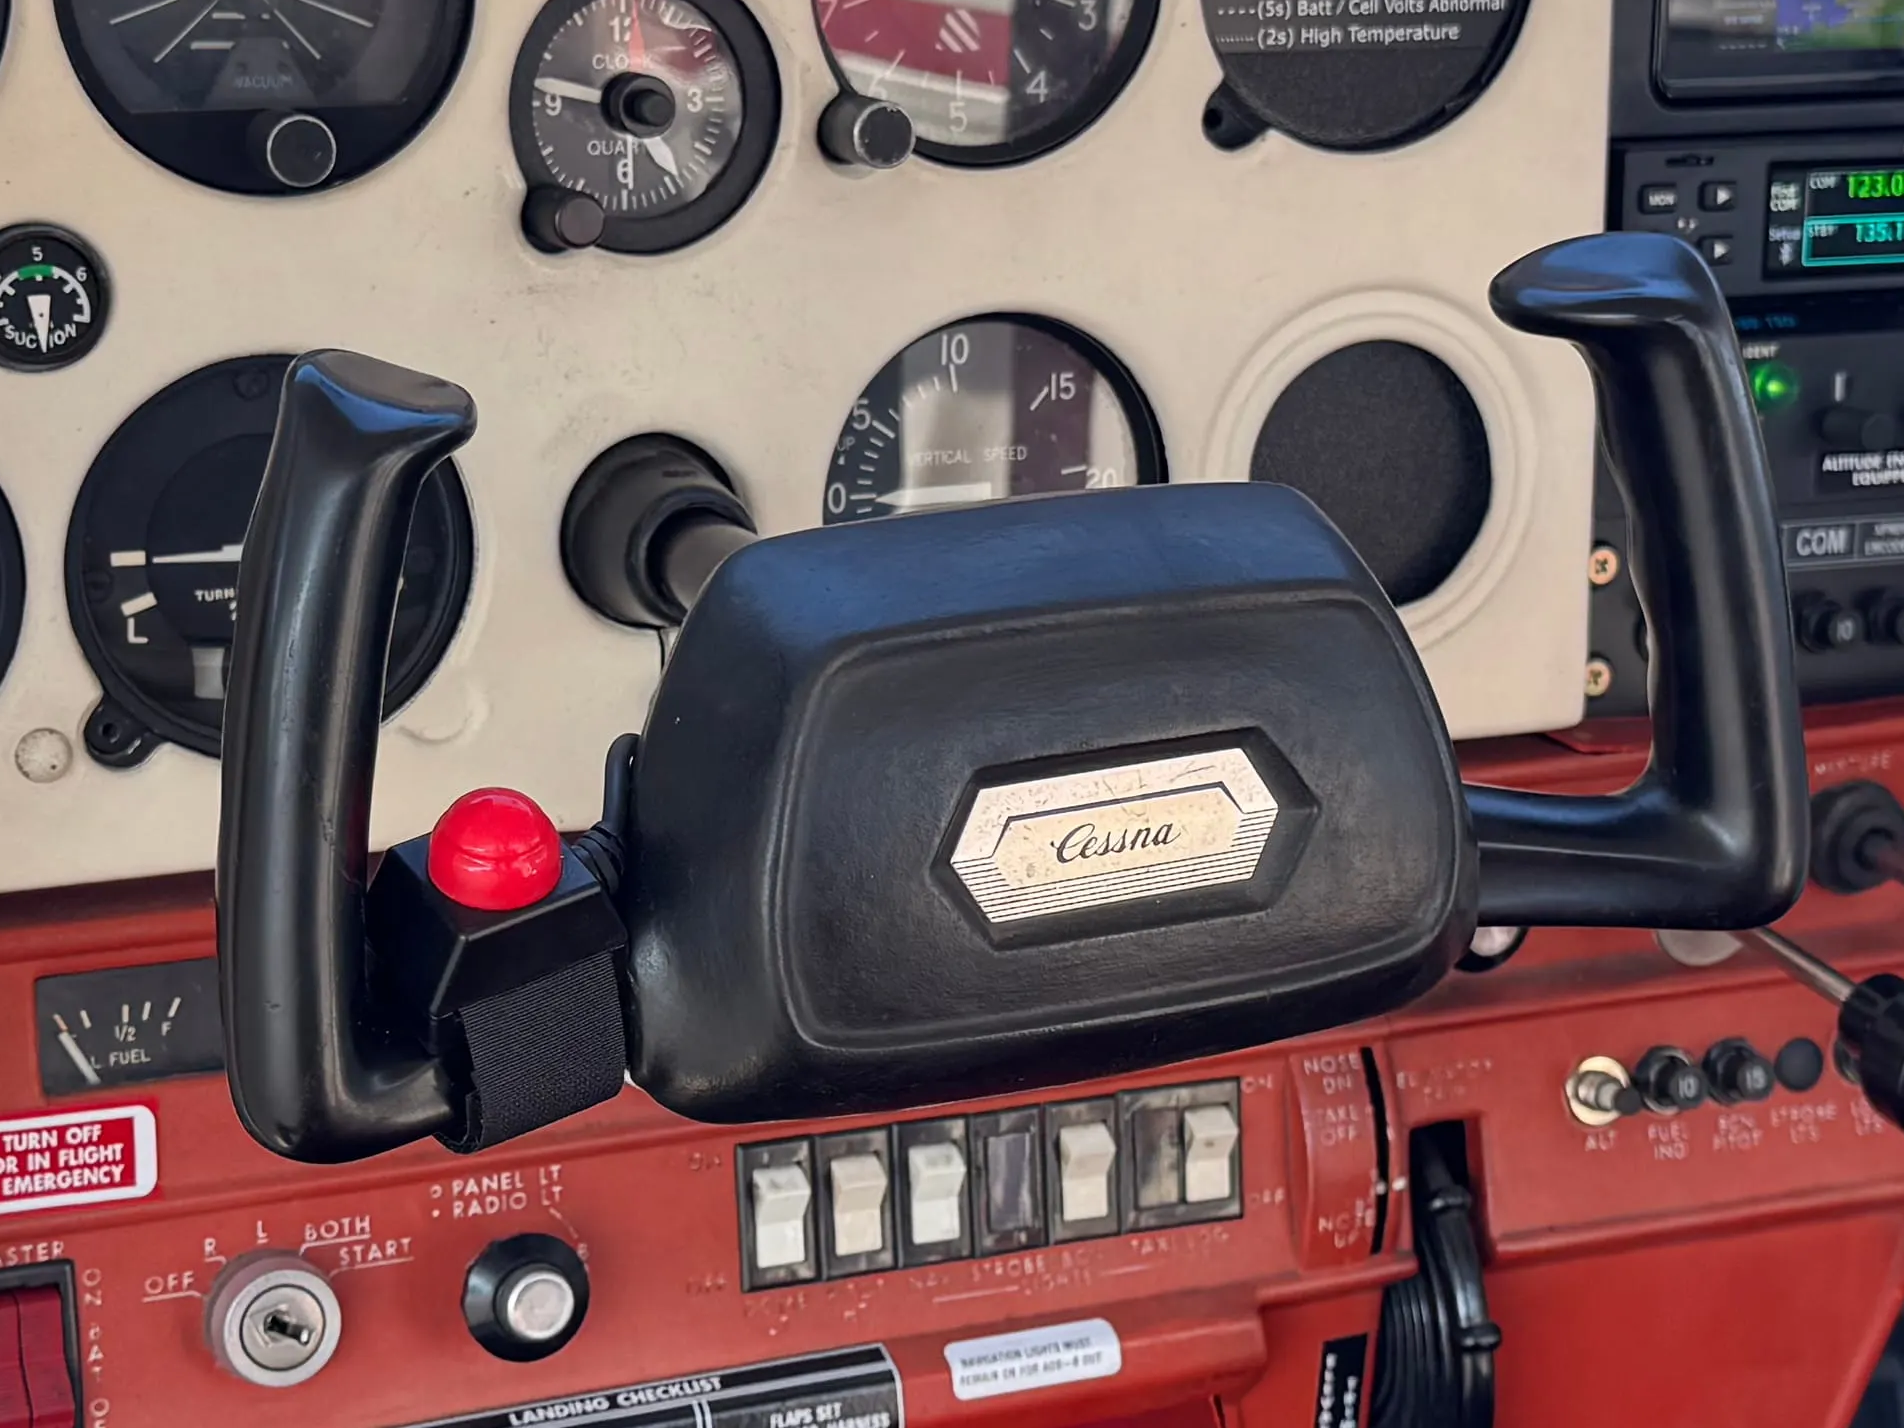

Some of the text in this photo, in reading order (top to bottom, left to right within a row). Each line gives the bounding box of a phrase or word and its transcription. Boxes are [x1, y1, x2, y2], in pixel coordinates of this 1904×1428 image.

[1257, 0, 1291, 22] (5s)
[1257, 24, 1460, 50] (2s) High Temperature
[940, 333, 970, 366] 10
[1835, 372, 1848, 401] 1
[983, 446, 1028, 461] SPEED
[1822, 452, 1884, 472] ALTITUDE
[1796, 528, 1847, 557] COM
[1050, 823, 1182, 864] Cessna
[109, 1049, 152, 1065] FUEL
[3, 1130, 58, 1154] TURN
[66, 1123, 103, 1143] OFF
[28, 1151, 51, 1172] IN
[58, 1143, 125, 1168] FLIGHT
[1, 1164, 125, 1198] EMERGENCY
[453, 1165, 562, 1197] PANEL LT
[453, 1186, 564, 1220] RADIO LT
[304, 1216, 372, 1243] BOTH
[339, 1237, 412, 1267] START
[143, 1271, 195, 1295] OFF
[509, 1377, 724, 1427] LANDING CHECKLIST
[816, 1402, 842, 1422] SET
